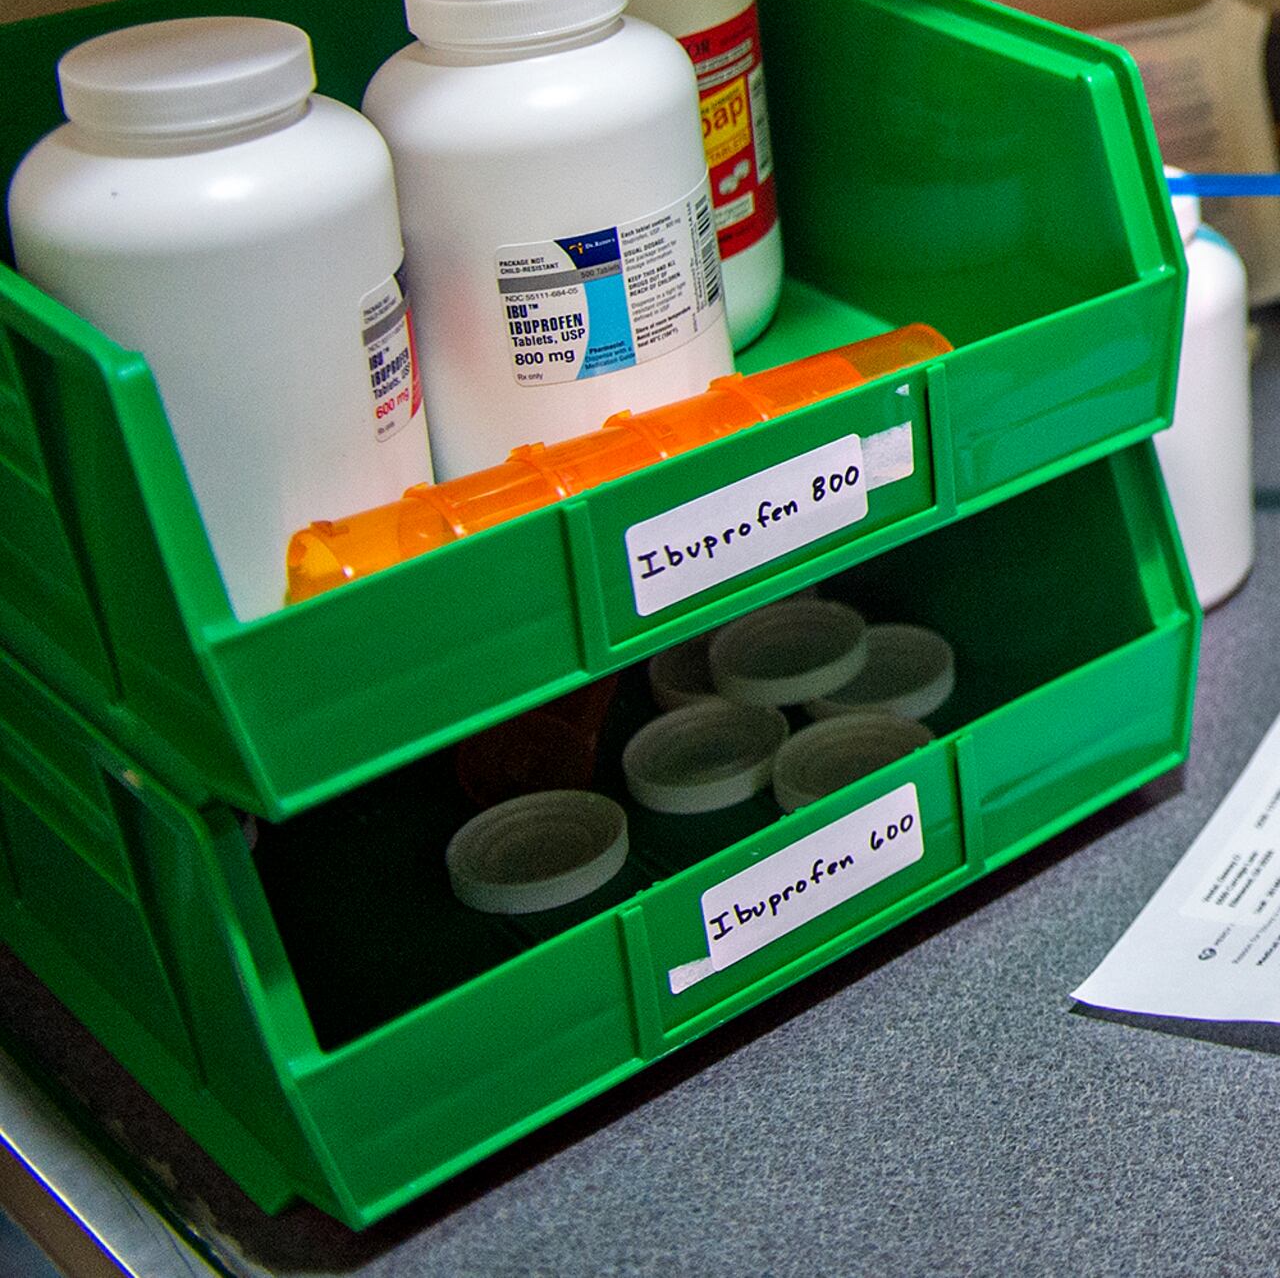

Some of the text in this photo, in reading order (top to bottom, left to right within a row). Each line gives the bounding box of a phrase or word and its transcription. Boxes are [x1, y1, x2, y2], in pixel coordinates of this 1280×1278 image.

[498, 257, 544, 267] PACKAGE NOT
[500, 262, 558, 275] CHILD-RESISTANT
[505, 295, 524, 303] NDC
[508, 313, 583, 336] IBUPROFEN
[511, 327, 585, 348] Tablets, USP
[514, 349, 575, 366] 800 mg
[528, 372, 544, 381] only
[376, 386, 409, 419] 600 mg
[638, 465, 860, 579] Ibuprofen 800
[709, 814, 914, 941] Ibuprofen 600
